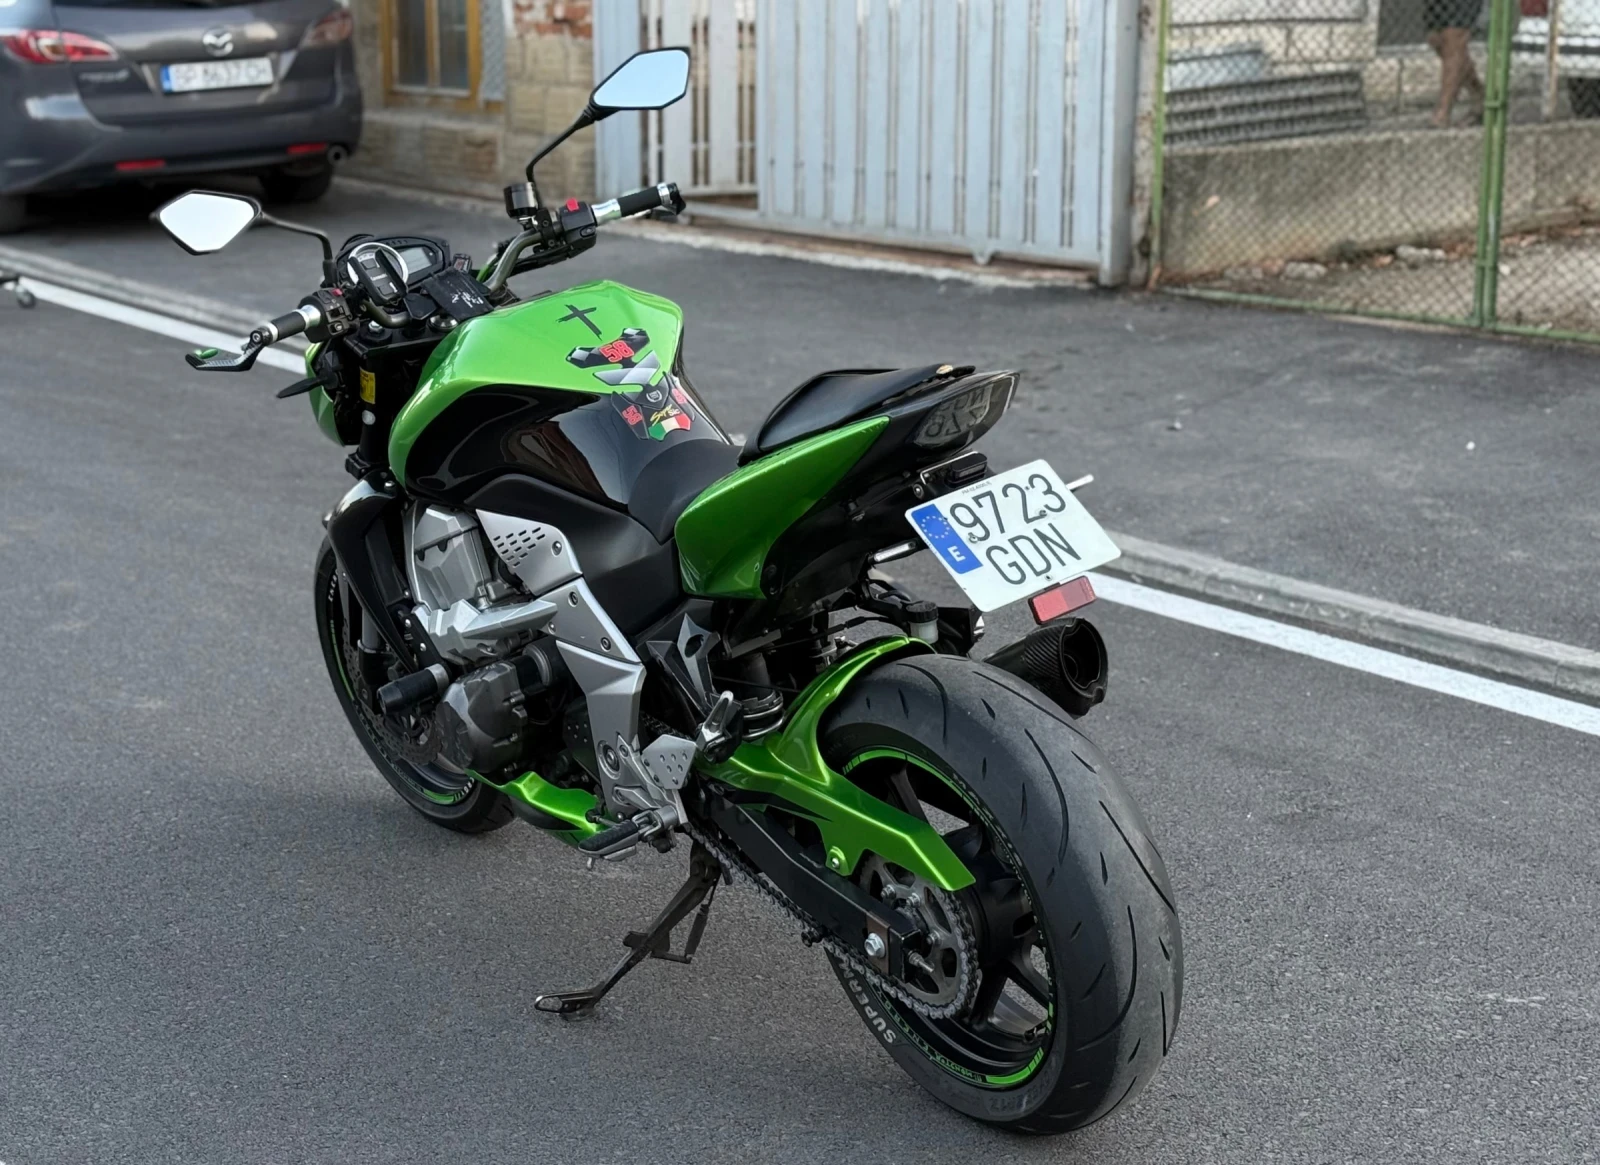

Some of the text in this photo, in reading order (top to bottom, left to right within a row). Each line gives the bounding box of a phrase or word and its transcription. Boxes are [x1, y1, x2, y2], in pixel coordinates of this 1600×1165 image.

[599, 340, 635, 363] 58
[621, 405, 643, 426] 58
[949, 473, 1066, 542] 9723
[947, 545, 966, 562] E
[985, 522, 1082, 586] GDN
